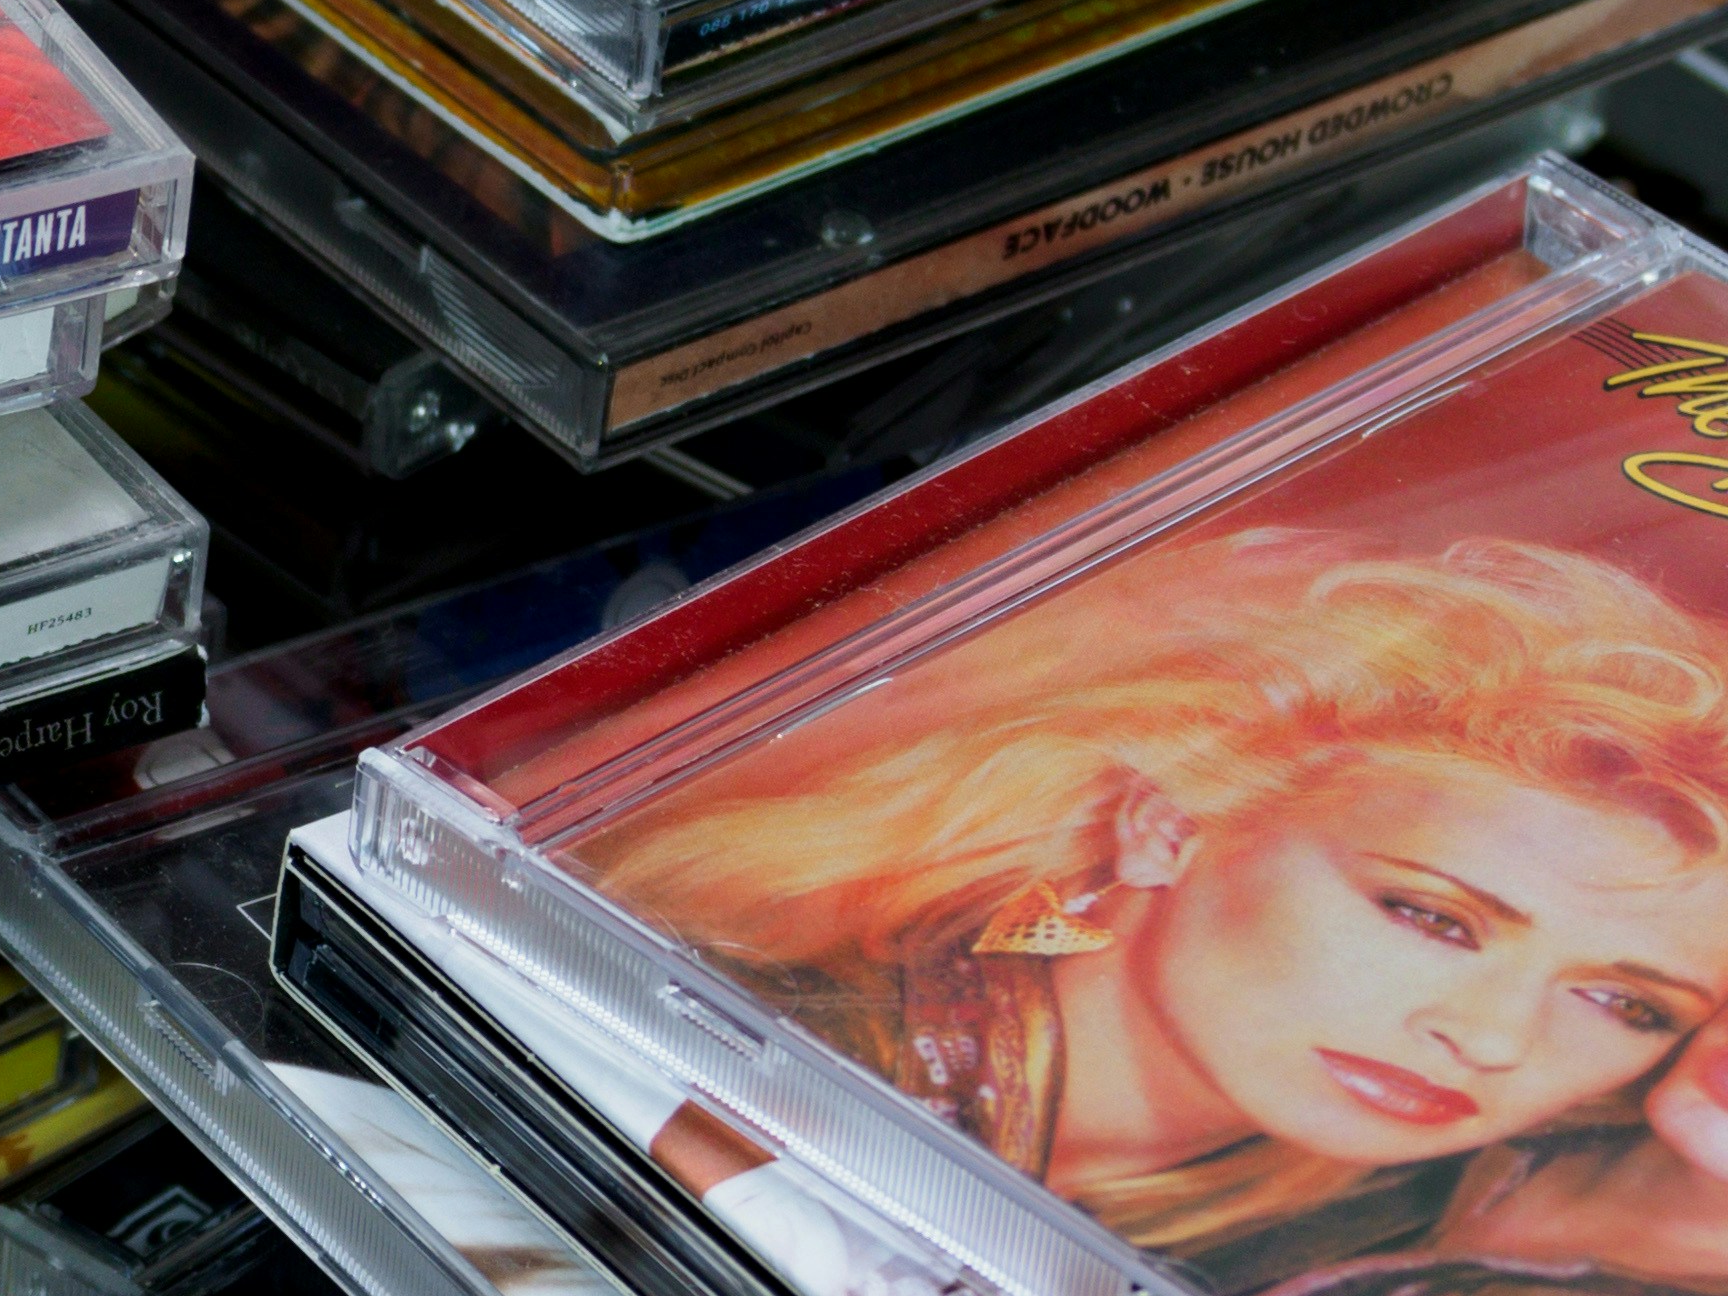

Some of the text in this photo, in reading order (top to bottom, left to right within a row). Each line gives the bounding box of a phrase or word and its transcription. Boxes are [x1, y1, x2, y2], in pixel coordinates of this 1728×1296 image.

[1308, 72, 1453, 147] CROWDED
[1202, 129, 1300, 188] HOUSE
[1004, 177, 1171, 261] WOODFACE
[104, 690, 163, 728] Roy
